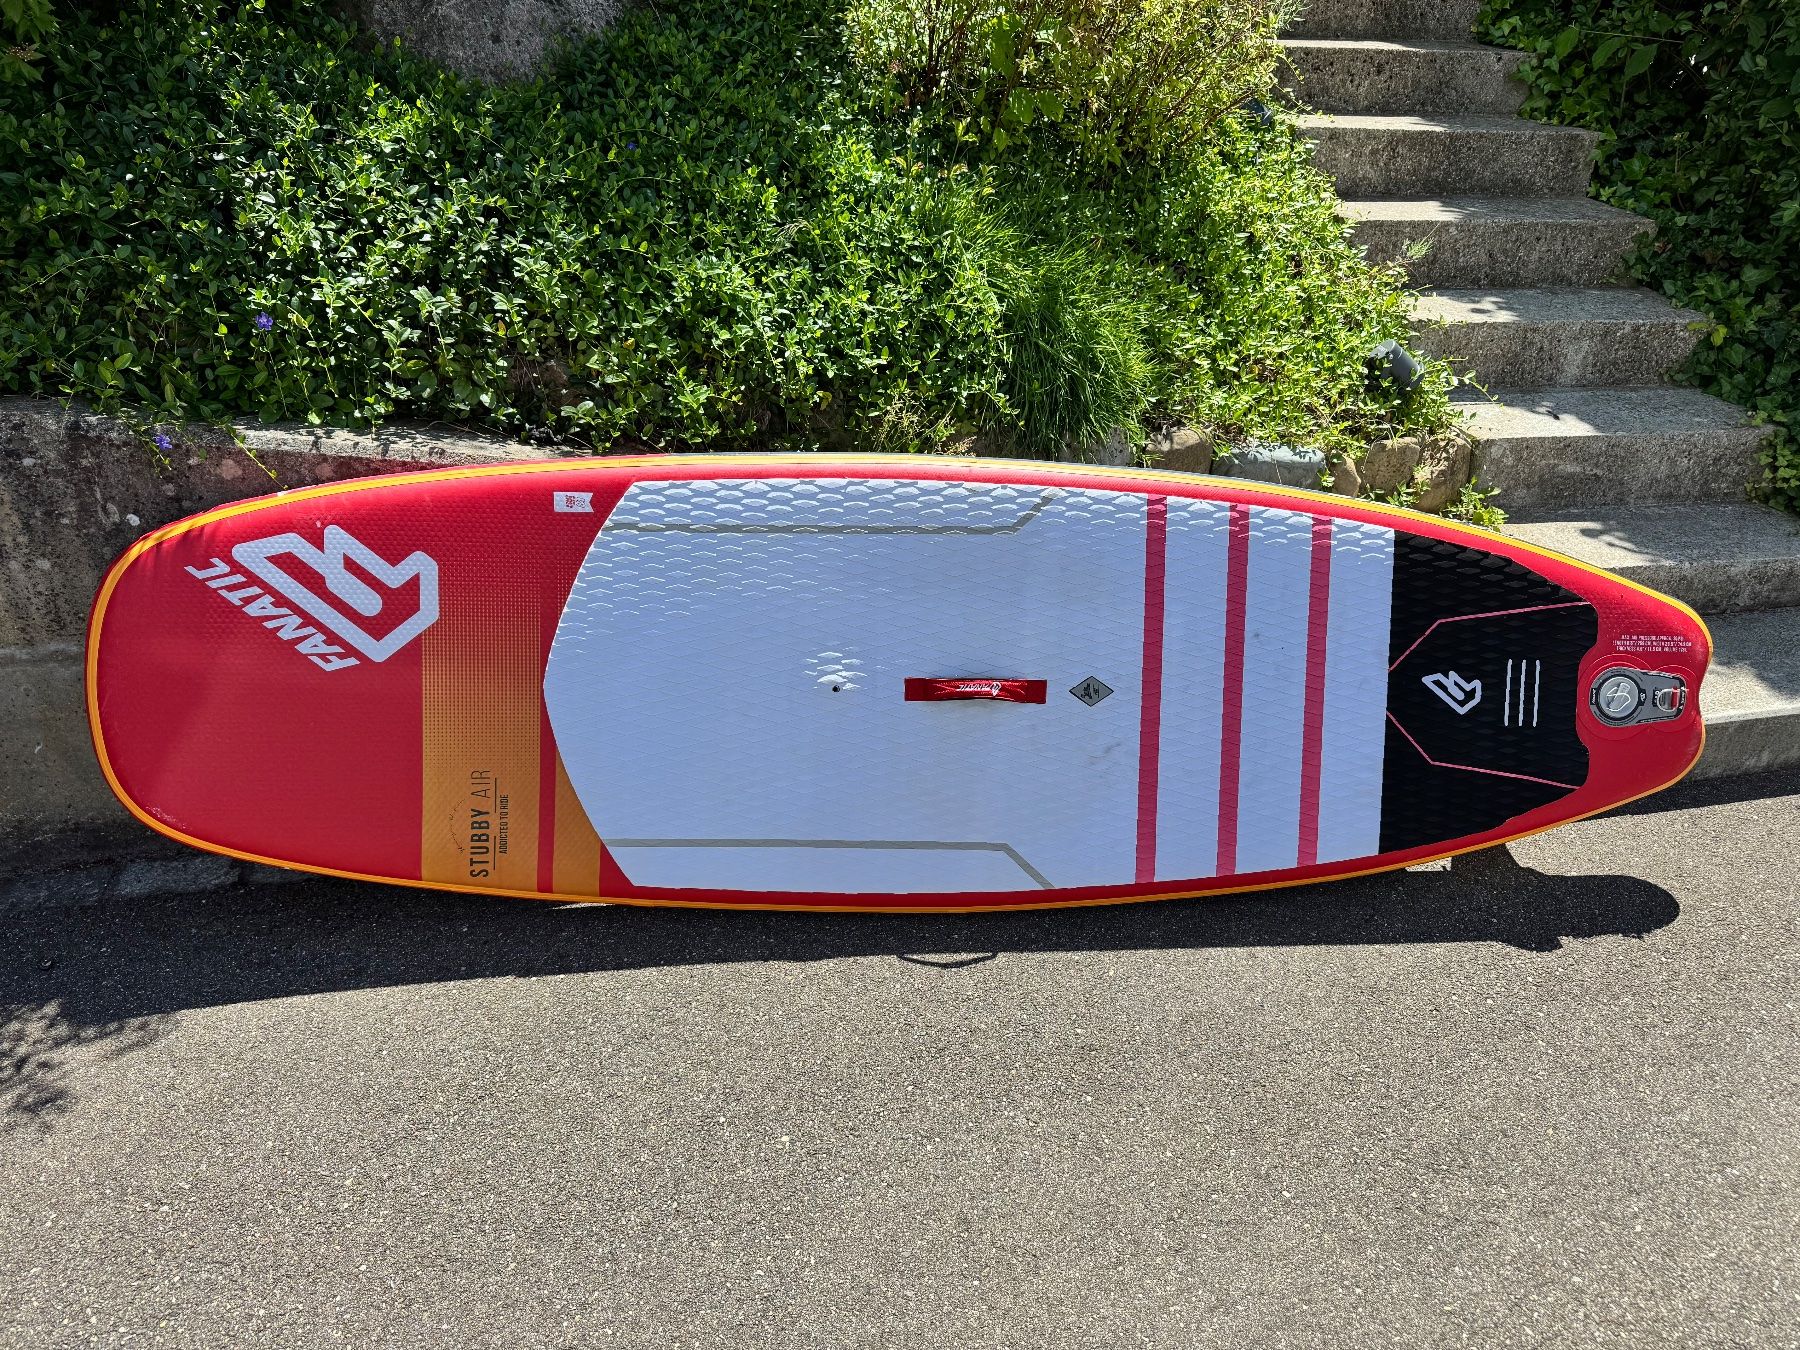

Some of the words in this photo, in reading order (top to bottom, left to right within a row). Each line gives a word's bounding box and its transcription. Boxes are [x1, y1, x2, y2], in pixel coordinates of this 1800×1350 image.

[184, 557, 361, 672] FANATIC
[470, 770, 491, 799] AIR
[499, 811, 509, 821] TO
[500, 794, 509, 811] RIDE
[469, 808, 490, 878] STUBBY
[499, 821, 509, 855] ADDICTED
